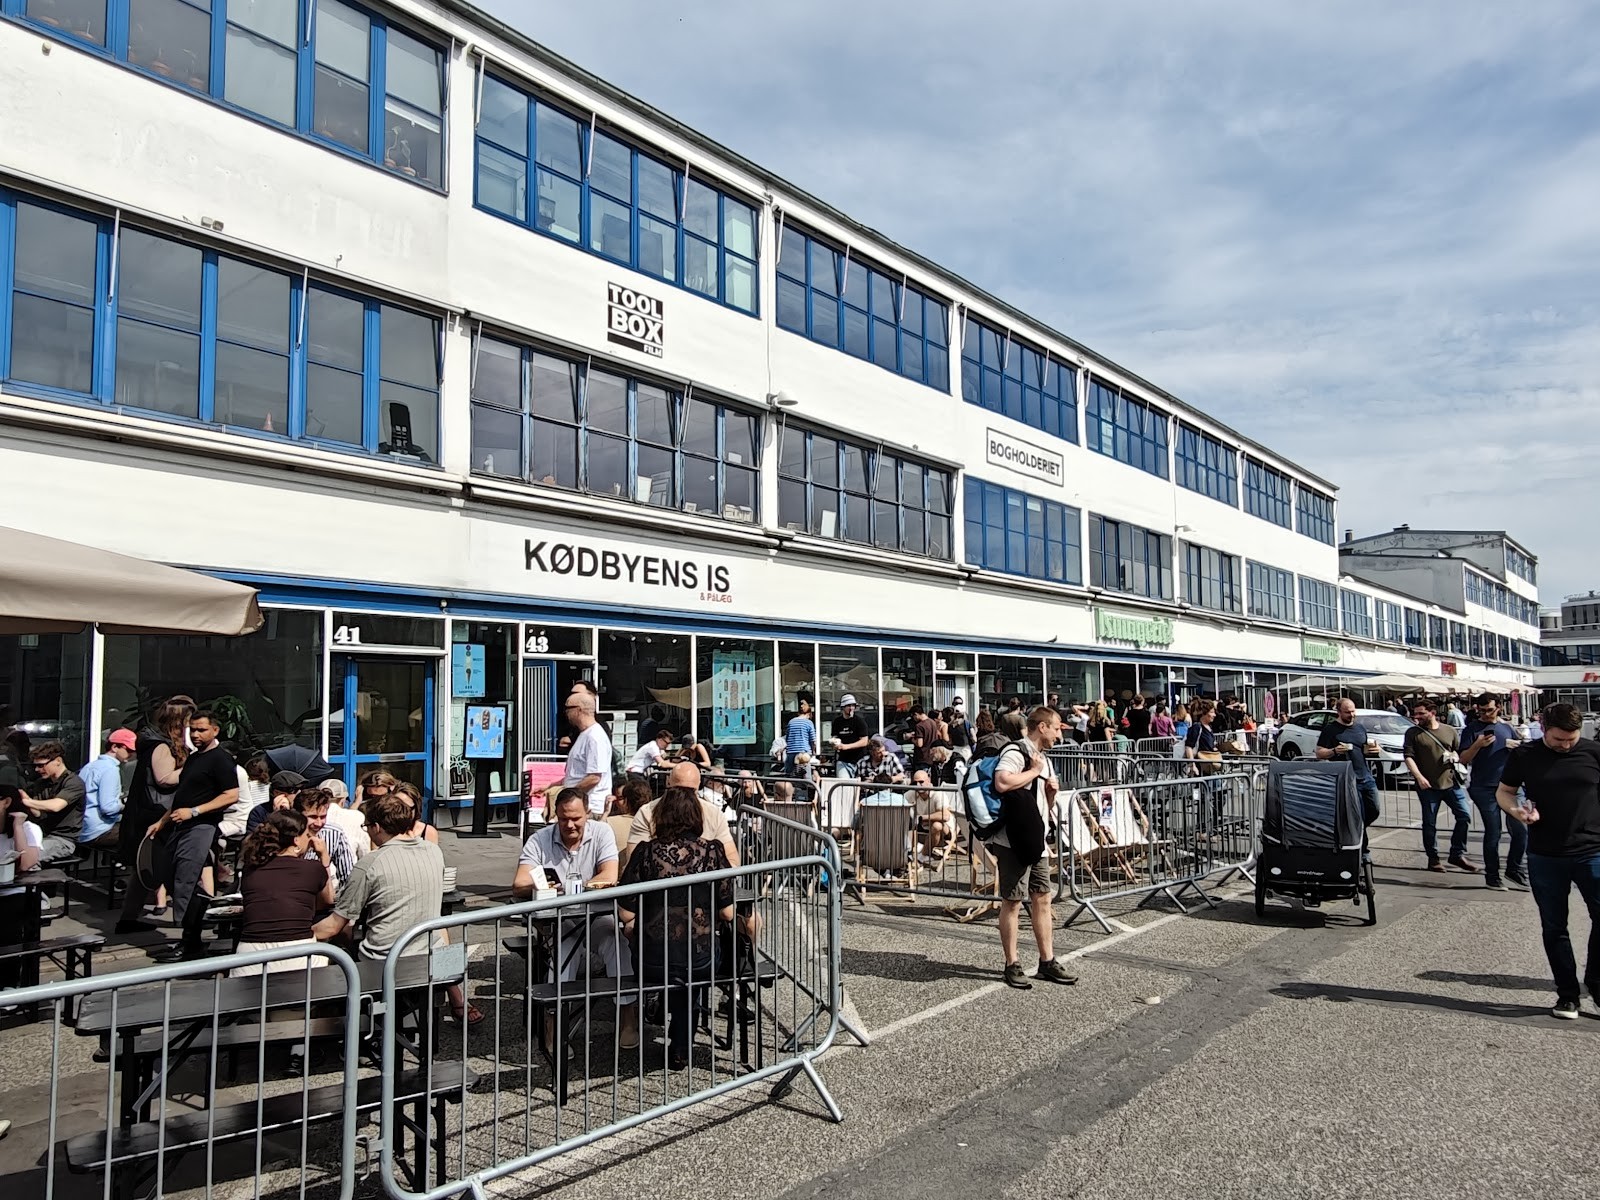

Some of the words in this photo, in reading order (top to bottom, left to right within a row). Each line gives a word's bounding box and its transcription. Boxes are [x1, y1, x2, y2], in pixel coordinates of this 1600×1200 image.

[608, 282, 662, 319] TOOL
[611, 306, 662, 344] BOX
[643, 344, 662, 357] FILM
[990, 440, 1060, 477] BOGHOLDERIET
[524, 538, 698, 589] KØDBYENS
[707, 564, 730, 593] IS
[334, 625, 361, 644] 41
[526, 636, 549, 653] 43
